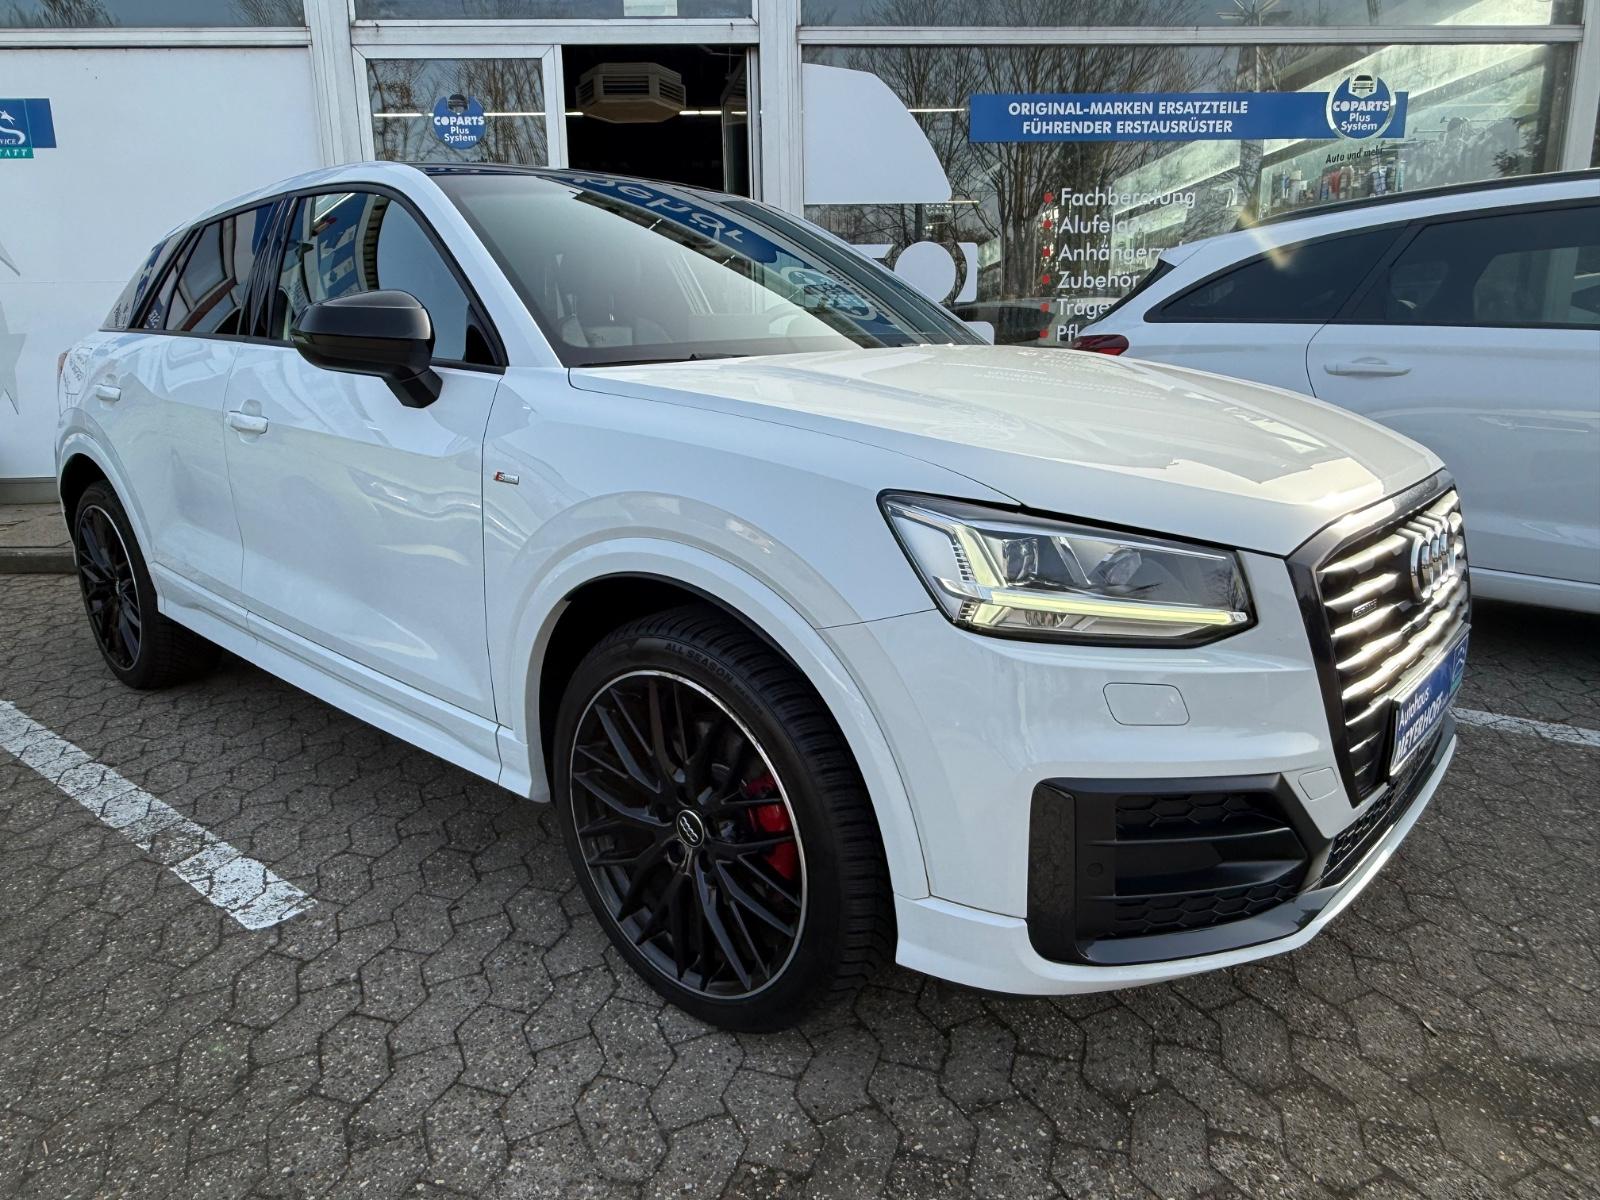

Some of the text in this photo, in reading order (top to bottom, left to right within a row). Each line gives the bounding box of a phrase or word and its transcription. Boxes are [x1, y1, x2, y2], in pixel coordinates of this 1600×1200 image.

[1008, 101, 1249, 115] ORIGINAL-MARKEN ERSATZTEILE
[1332, 100, 1390, 112] COPARTS
[433, 116, 485, 126] COPARTS
[1349, 112, 1371, 122] Plus
[450, 126, 470, 134] Plus
[1023, 117, 1233, 134] FÜHRENDER ERSTAUSRÜSTER
[1341, 121, 1378, 133] System
[444, 133, 477, 143] System
[1326, 153, 1345, 165] Auto
[1347, 147, 1363, 160] und
[1061, 187, 1196, 208] Fachberatung
[1057, 270, 1141, 289] Zubehör
[665, 643, 684, 655] ALL
[687, 650, 735, 684] SEASON
[1399, 687, 1430, 727] Autohaus
